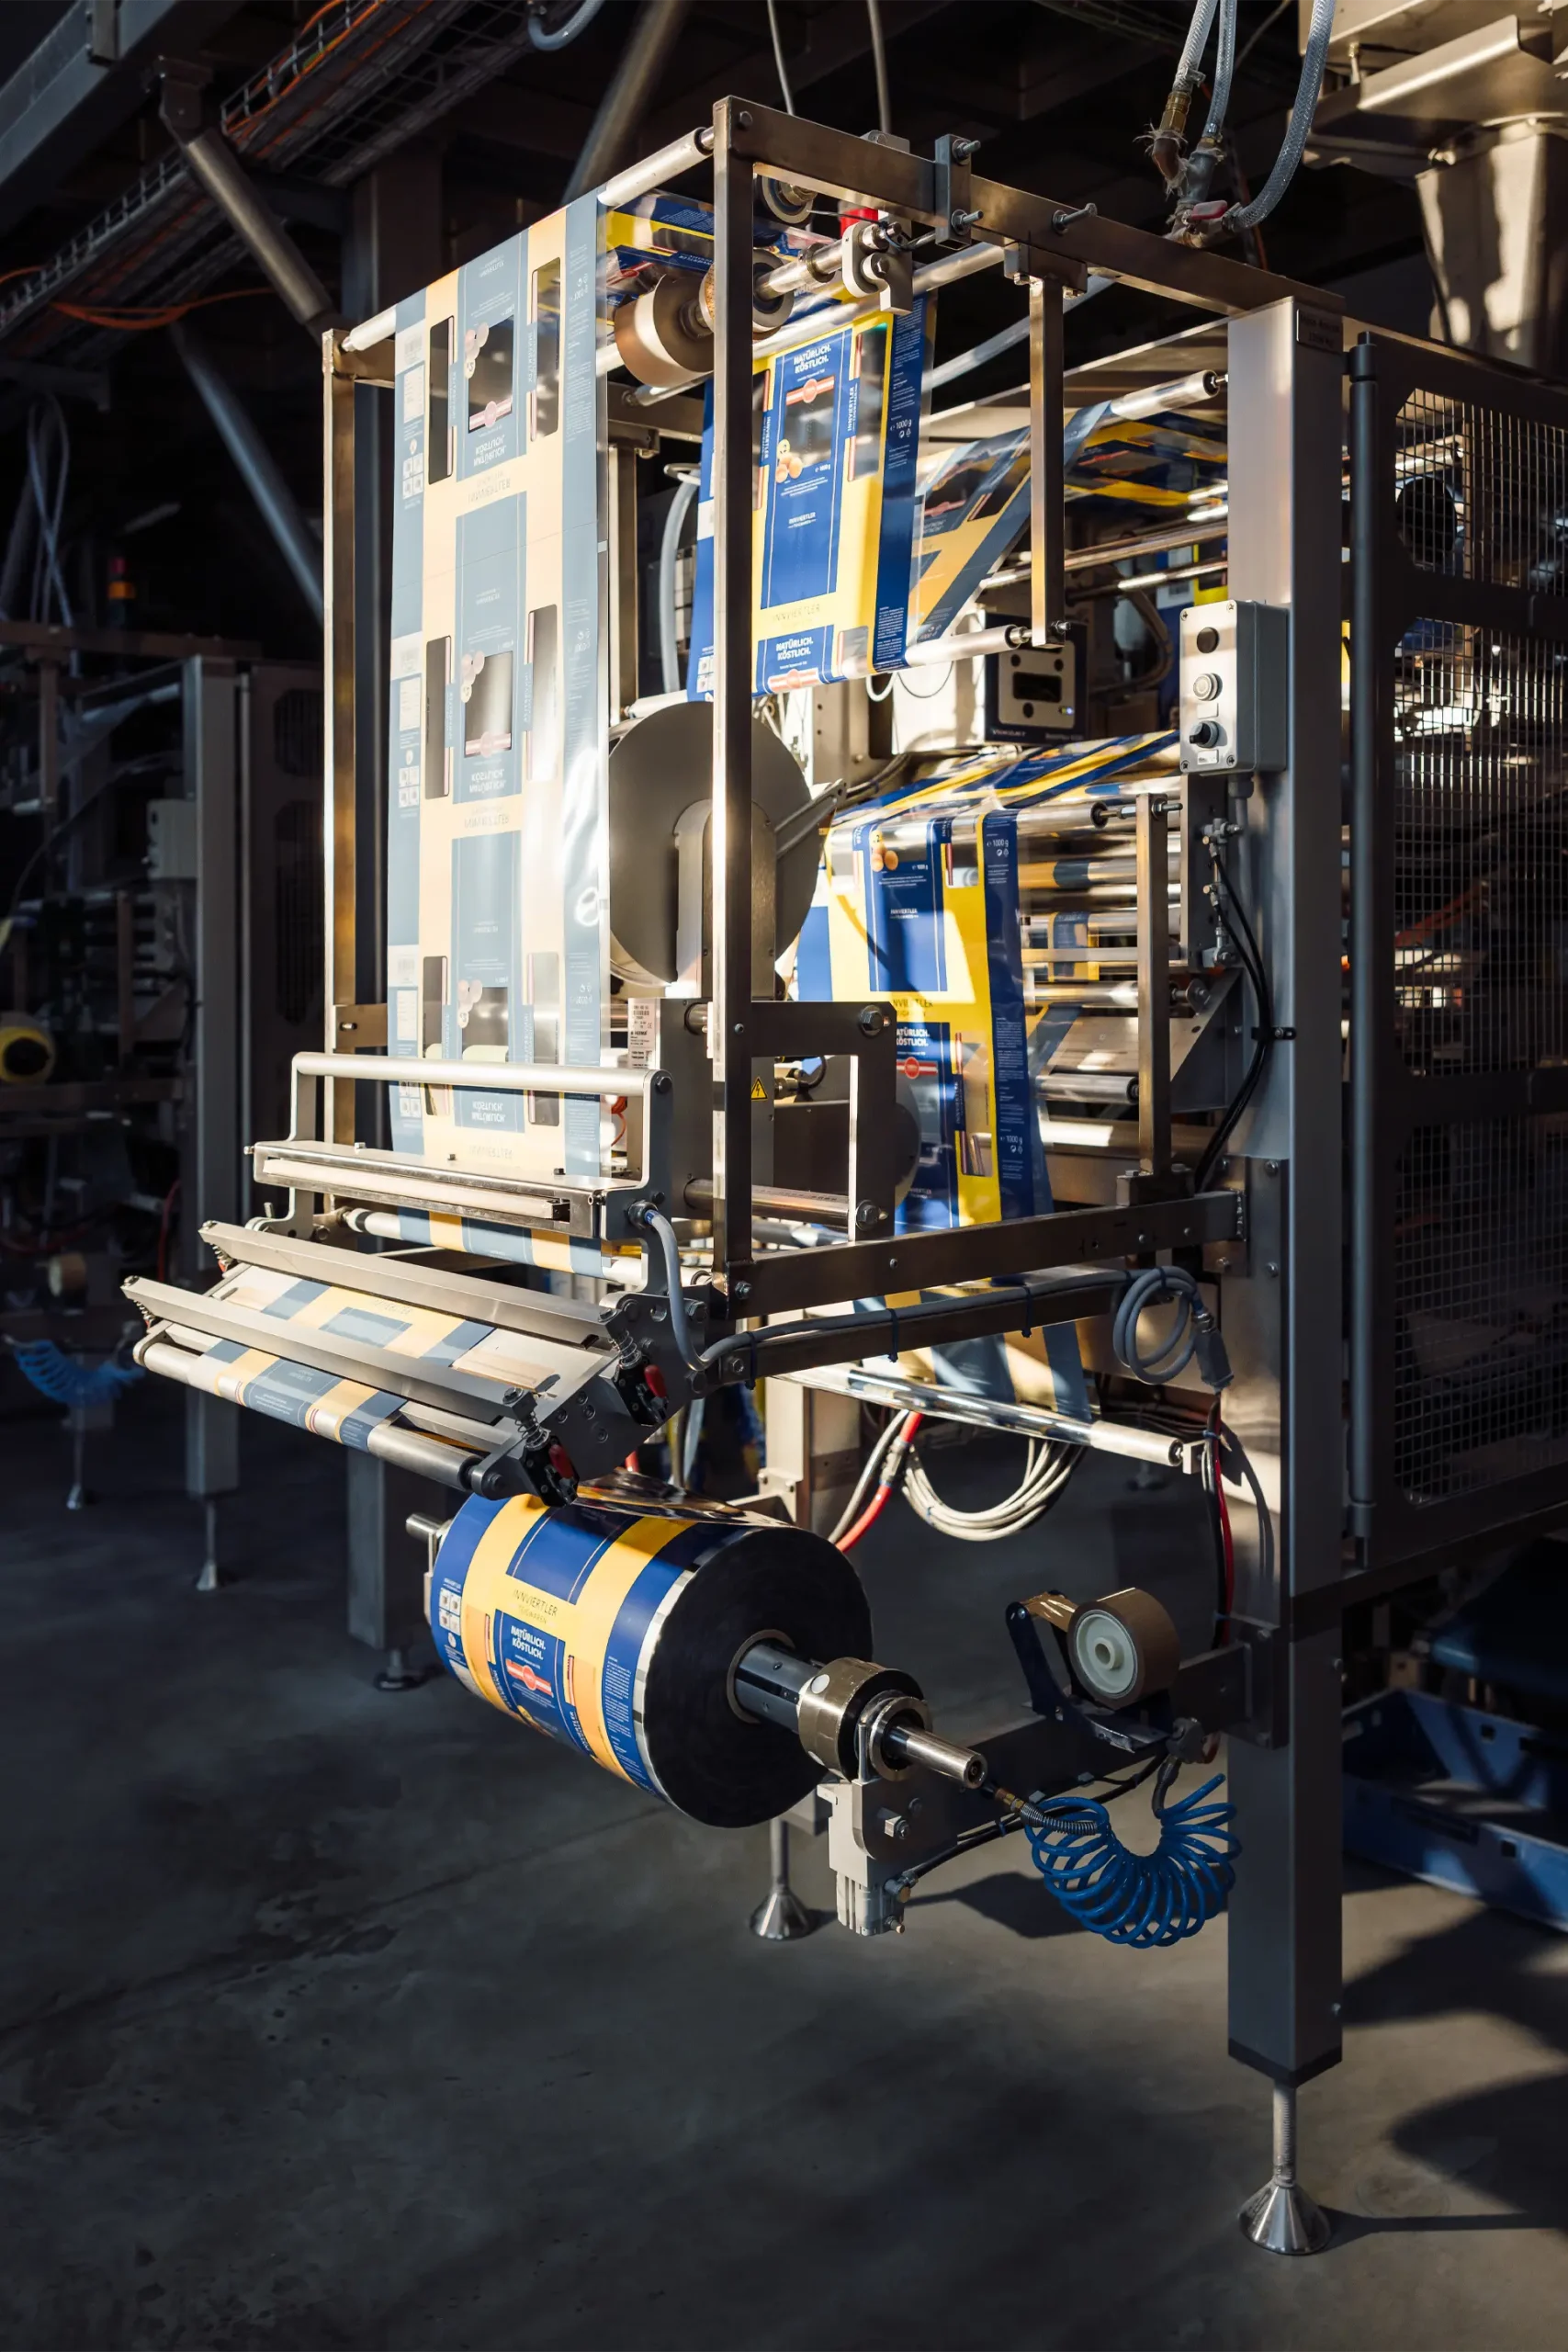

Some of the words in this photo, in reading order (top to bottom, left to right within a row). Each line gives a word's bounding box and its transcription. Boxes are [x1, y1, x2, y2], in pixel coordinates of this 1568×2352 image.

[794, 344, 831, 365] NATÜRLICH.
[795, 355, 829, 374] KÖSTLICH.
[775, 637, 814, 651] NATÜRLICH.
[777, 647, 811, 661] KÖSTLICH.
[993, 839, 1004, 847] 1000
[897, 1026, 930, 1037] ATÜRLICH.
[513, 1589, 558, 1616] INNVIERTLER
[511, 1625, 546, 1650] NATÜRLICH.
[512, 1637, 544, 1660] KÖSTLICH.
